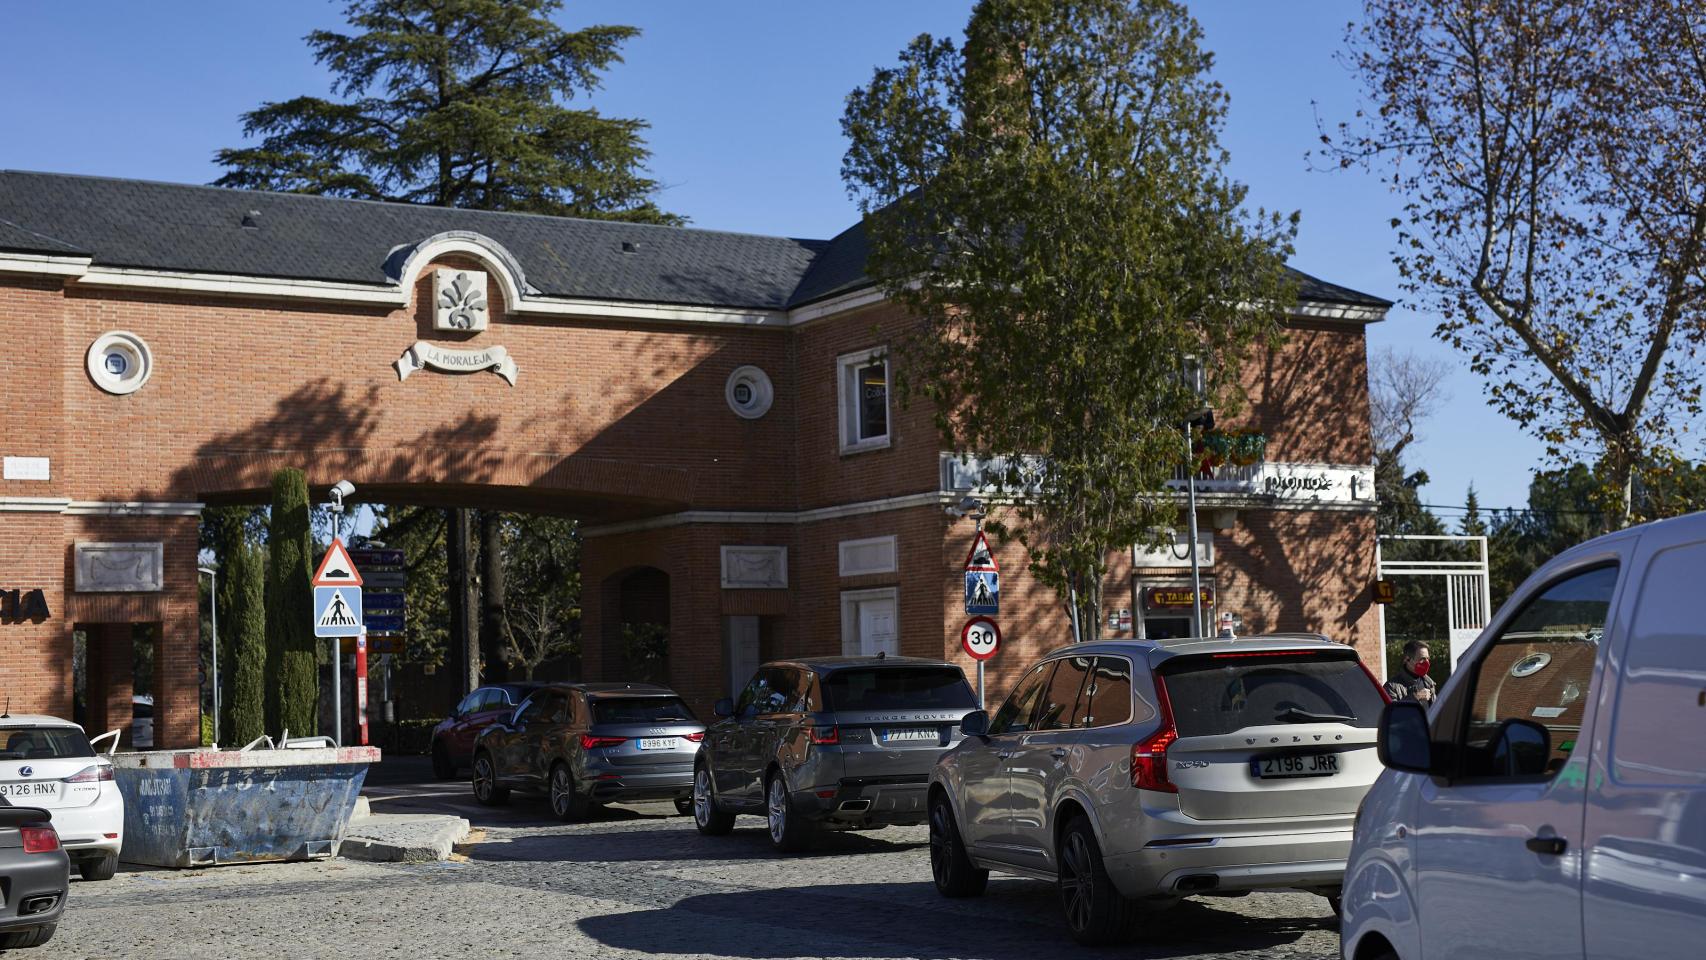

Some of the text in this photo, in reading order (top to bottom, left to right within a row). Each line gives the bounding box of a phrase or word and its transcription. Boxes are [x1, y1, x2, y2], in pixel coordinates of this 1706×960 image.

[427, 349, 492, 366] LA MORALEJA
[1166, 592, 1208, 602] TABACS
[971, 631, 993, 645] 30
[889, 728, 936, 740] 7717 KNX
[1246, 734, 1343, 745] VOLVO
[1264, 755, 1338, 773] 2196 JRR
[0, 783, 56, 796] 9126 HNX
